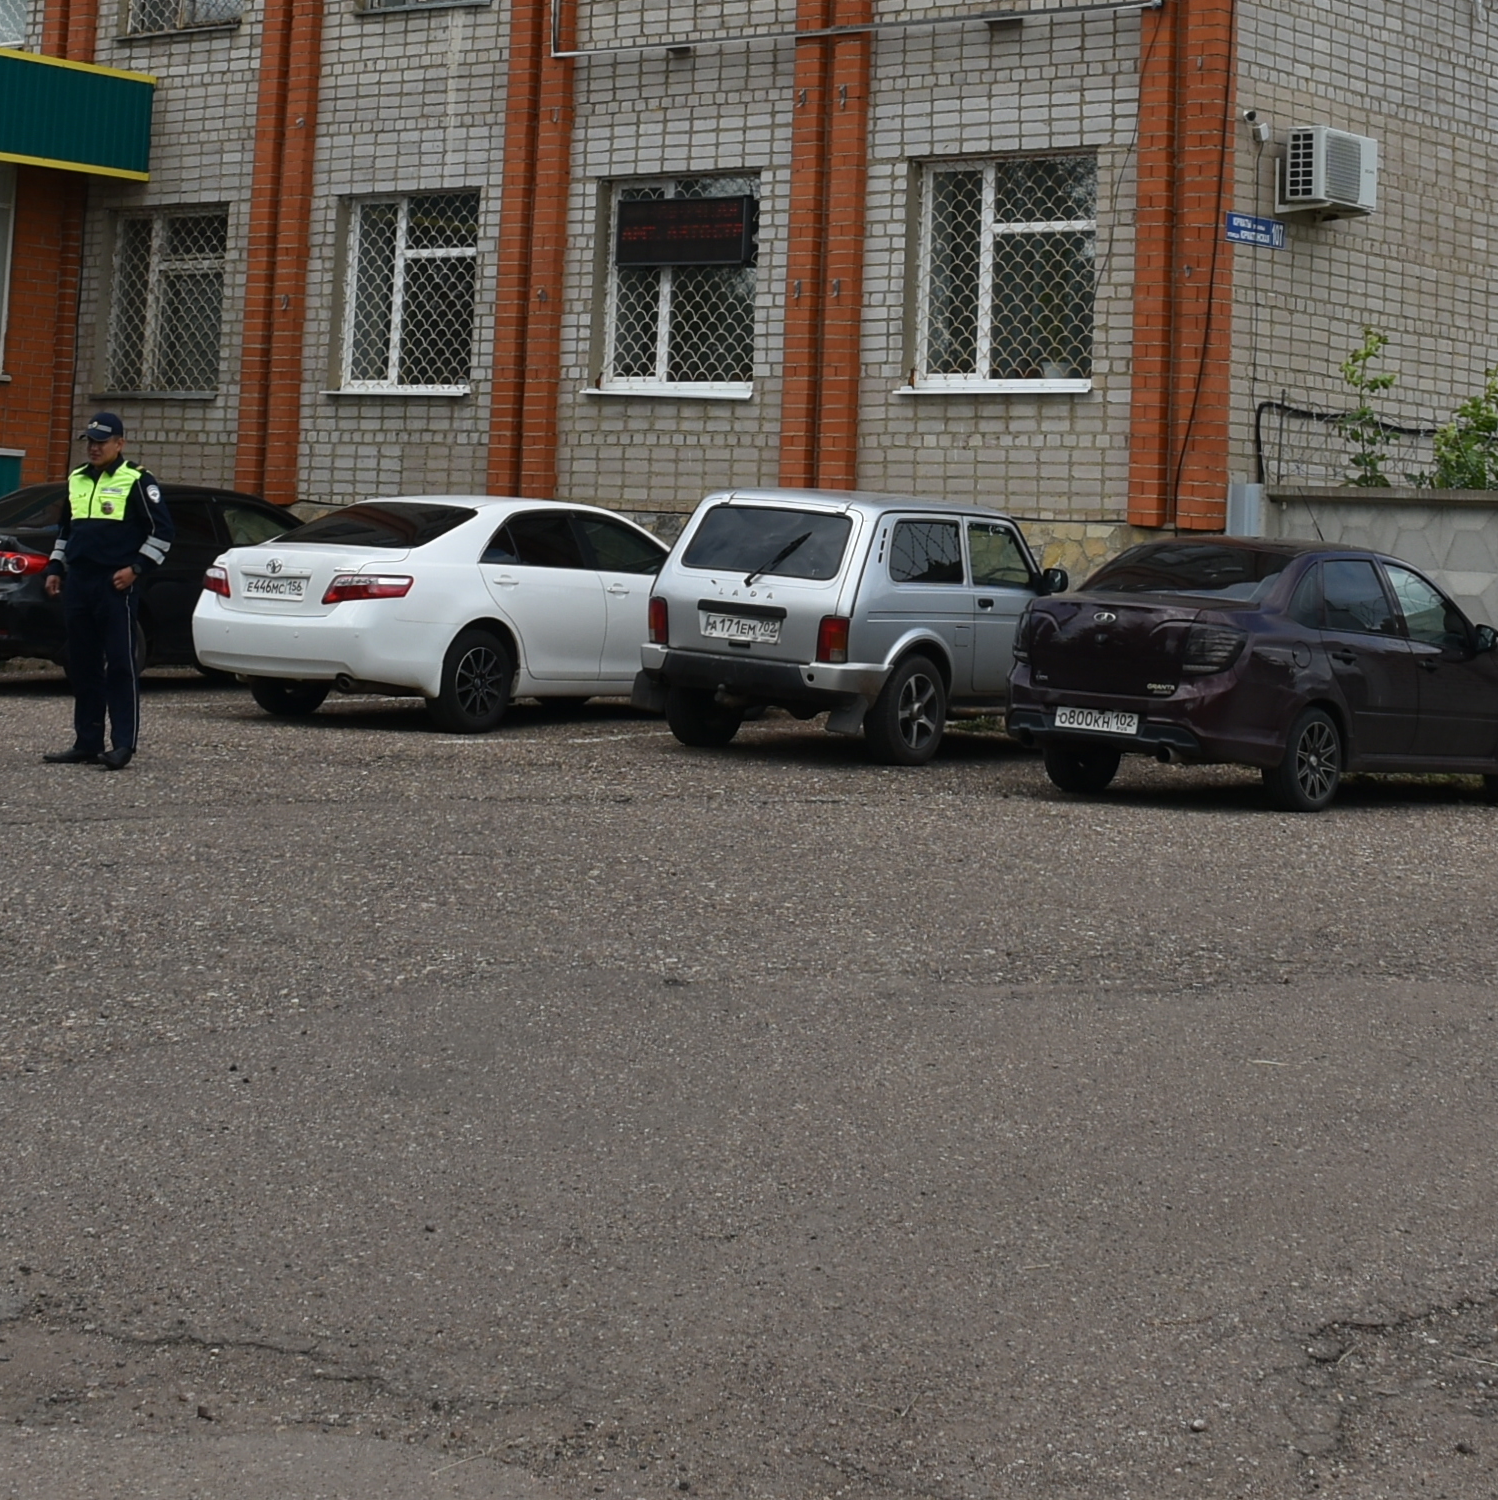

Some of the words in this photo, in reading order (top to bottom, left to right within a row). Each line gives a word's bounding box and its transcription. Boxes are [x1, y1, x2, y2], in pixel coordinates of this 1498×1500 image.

[287, 580, 303, 592] 156
[718, 587, 773, 599] LADA
[1147, 683, 1175, 691] GRANTA
[1113, 713, 1133, 728] 102
